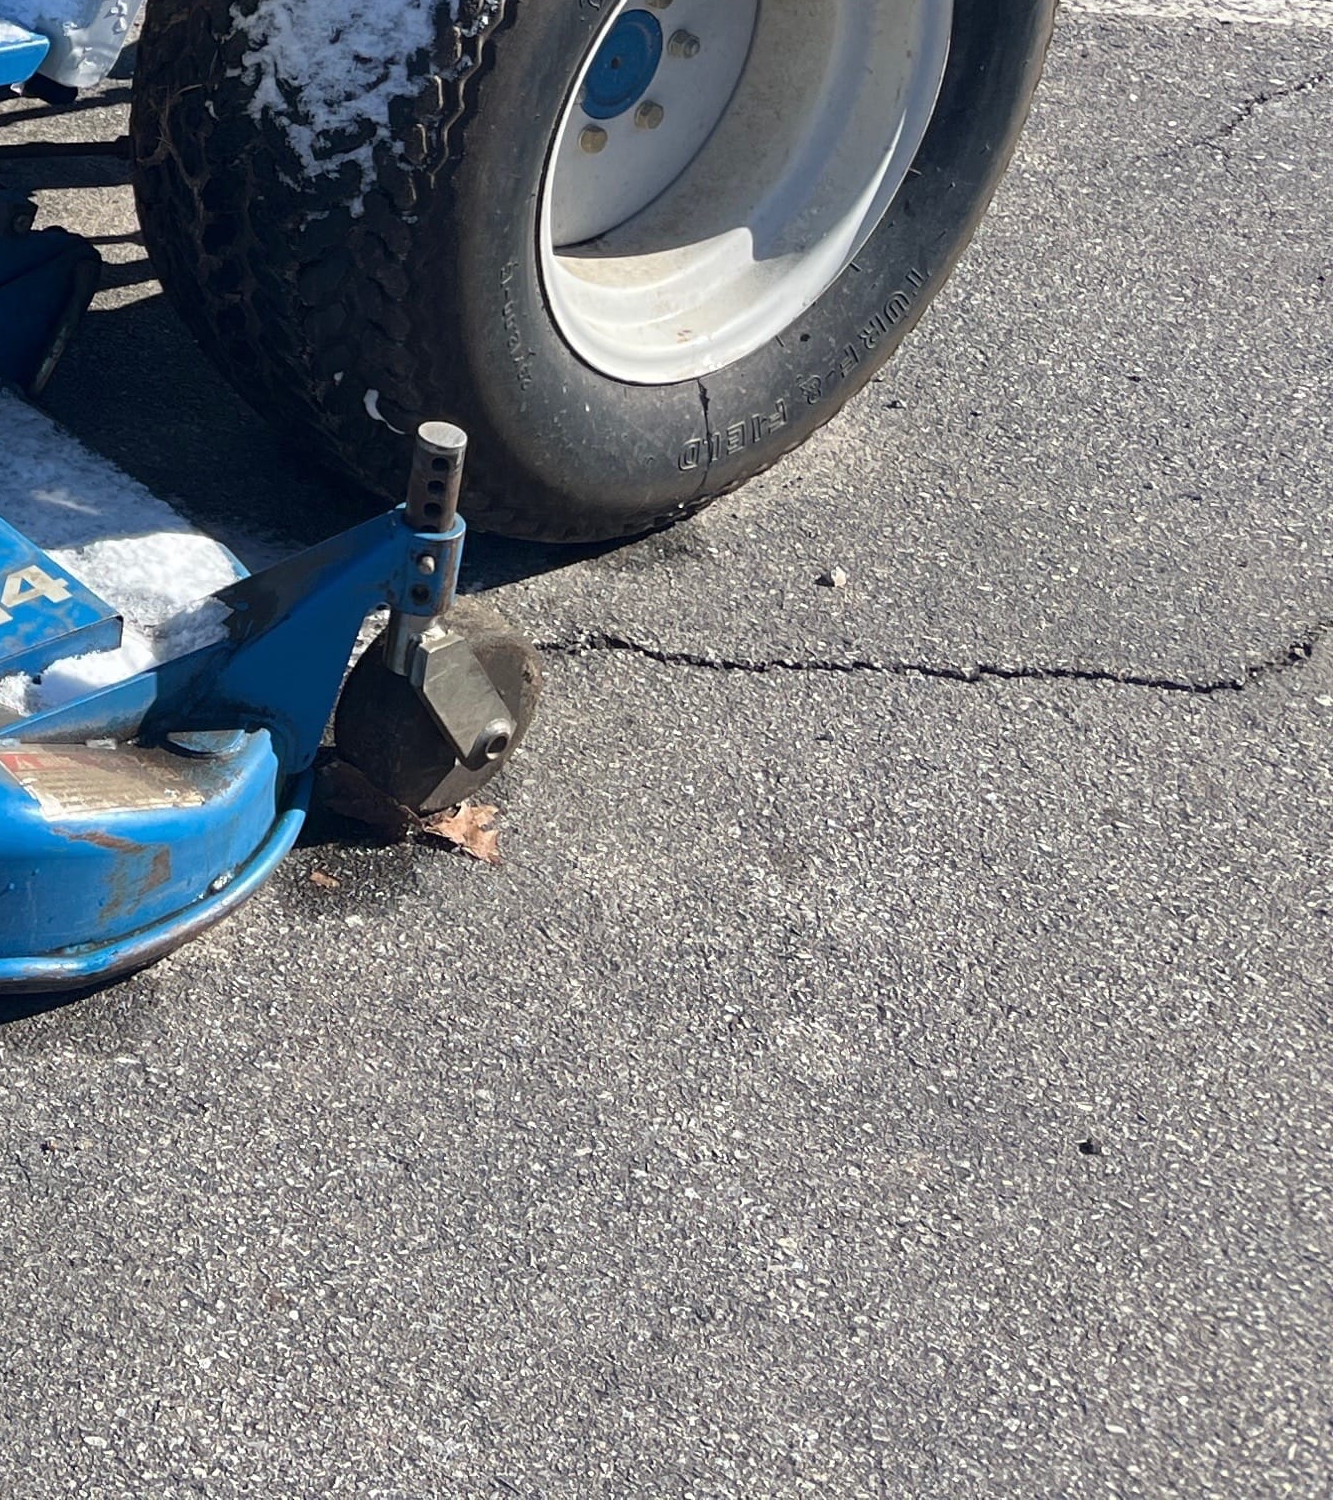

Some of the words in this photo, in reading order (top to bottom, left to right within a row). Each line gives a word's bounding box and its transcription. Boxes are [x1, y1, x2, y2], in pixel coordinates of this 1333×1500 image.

[838, 265, 934, 380] TURF
[797, 373, 824, 406] &
[675, 396, 790, 472] FIELD
